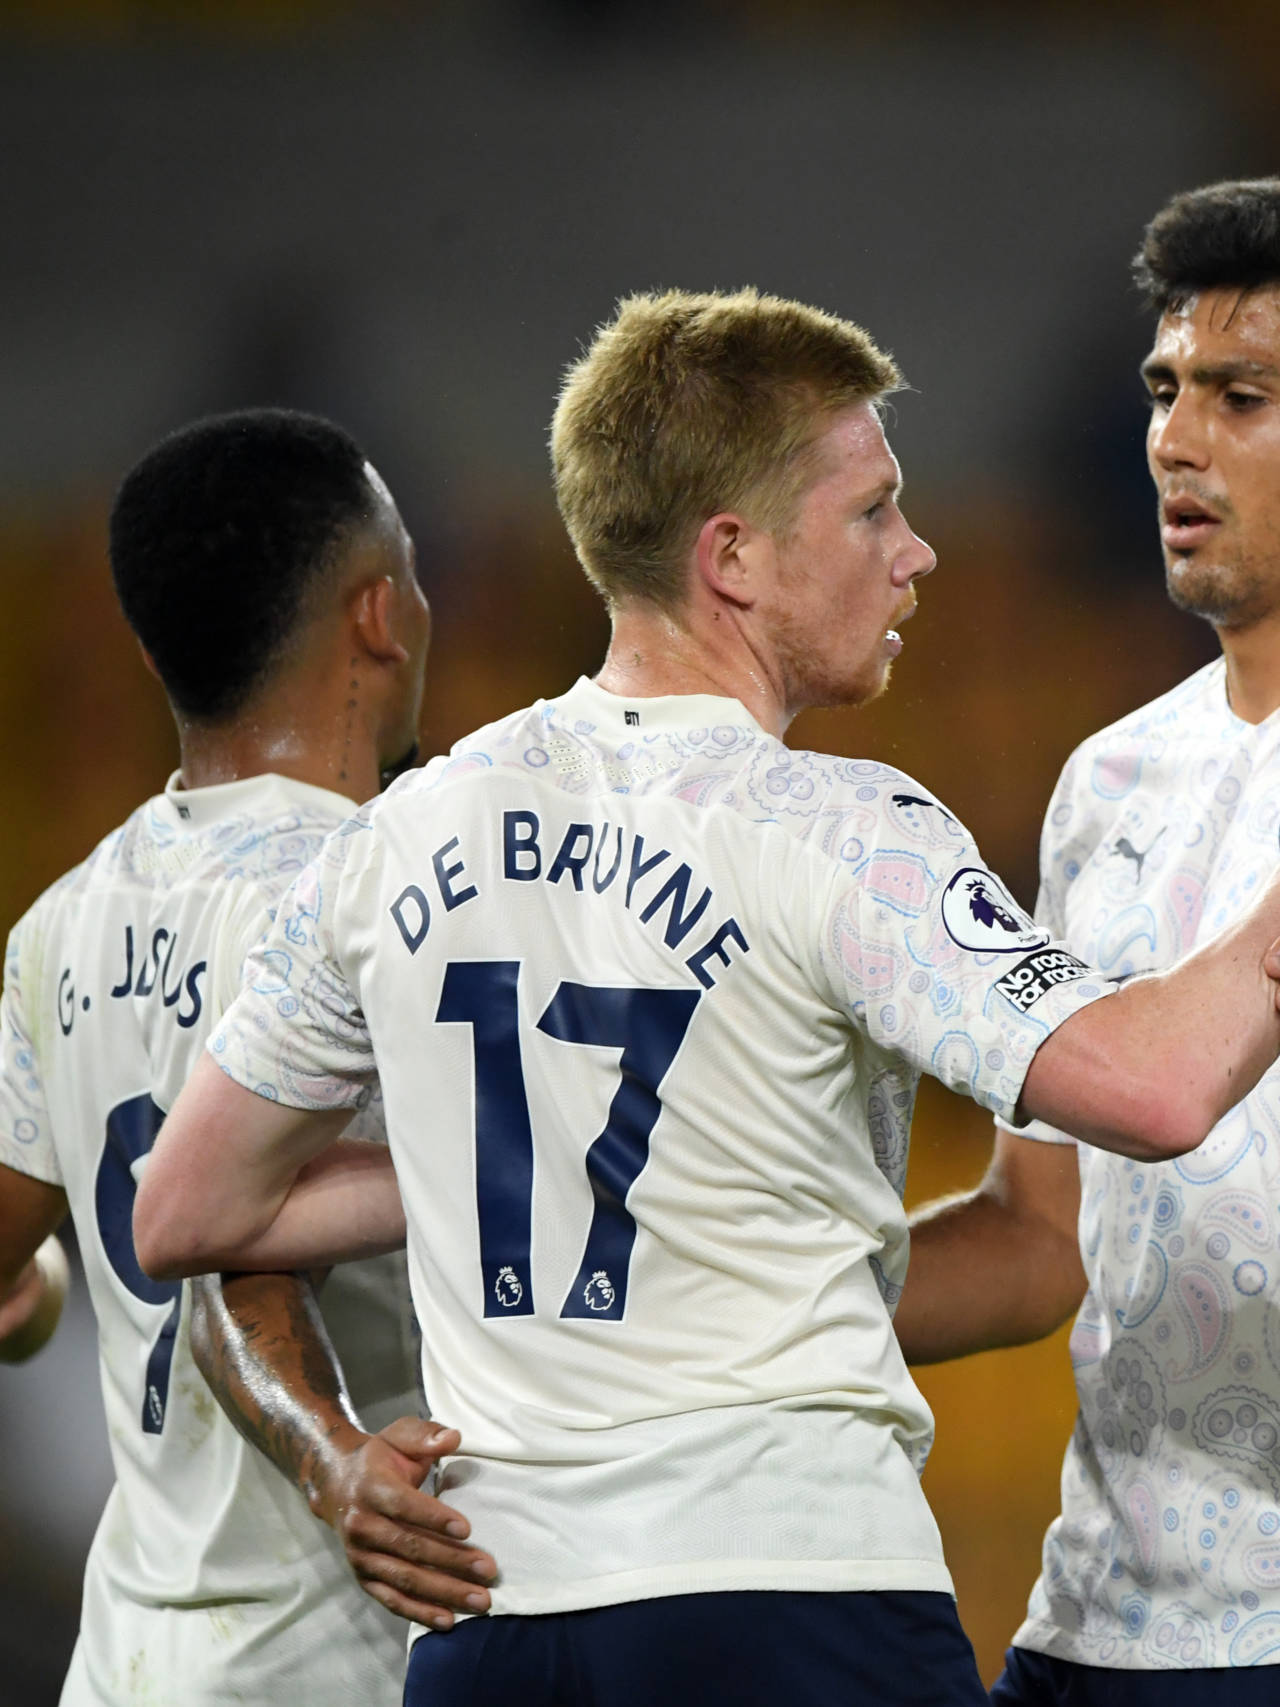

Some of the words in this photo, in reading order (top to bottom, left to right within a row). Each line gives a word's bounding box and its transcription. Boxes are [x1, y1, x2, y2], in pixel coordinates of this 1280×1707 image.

[390, 838, 478, 955] DE
[503, 810, 749, 990] BRUYNE
[58, 967, 91, 1037] G.
[994, 967, 1034, 1000] No
[1010, 978, 1046, 1013] for
[435, 961, 702, 1321] 17
